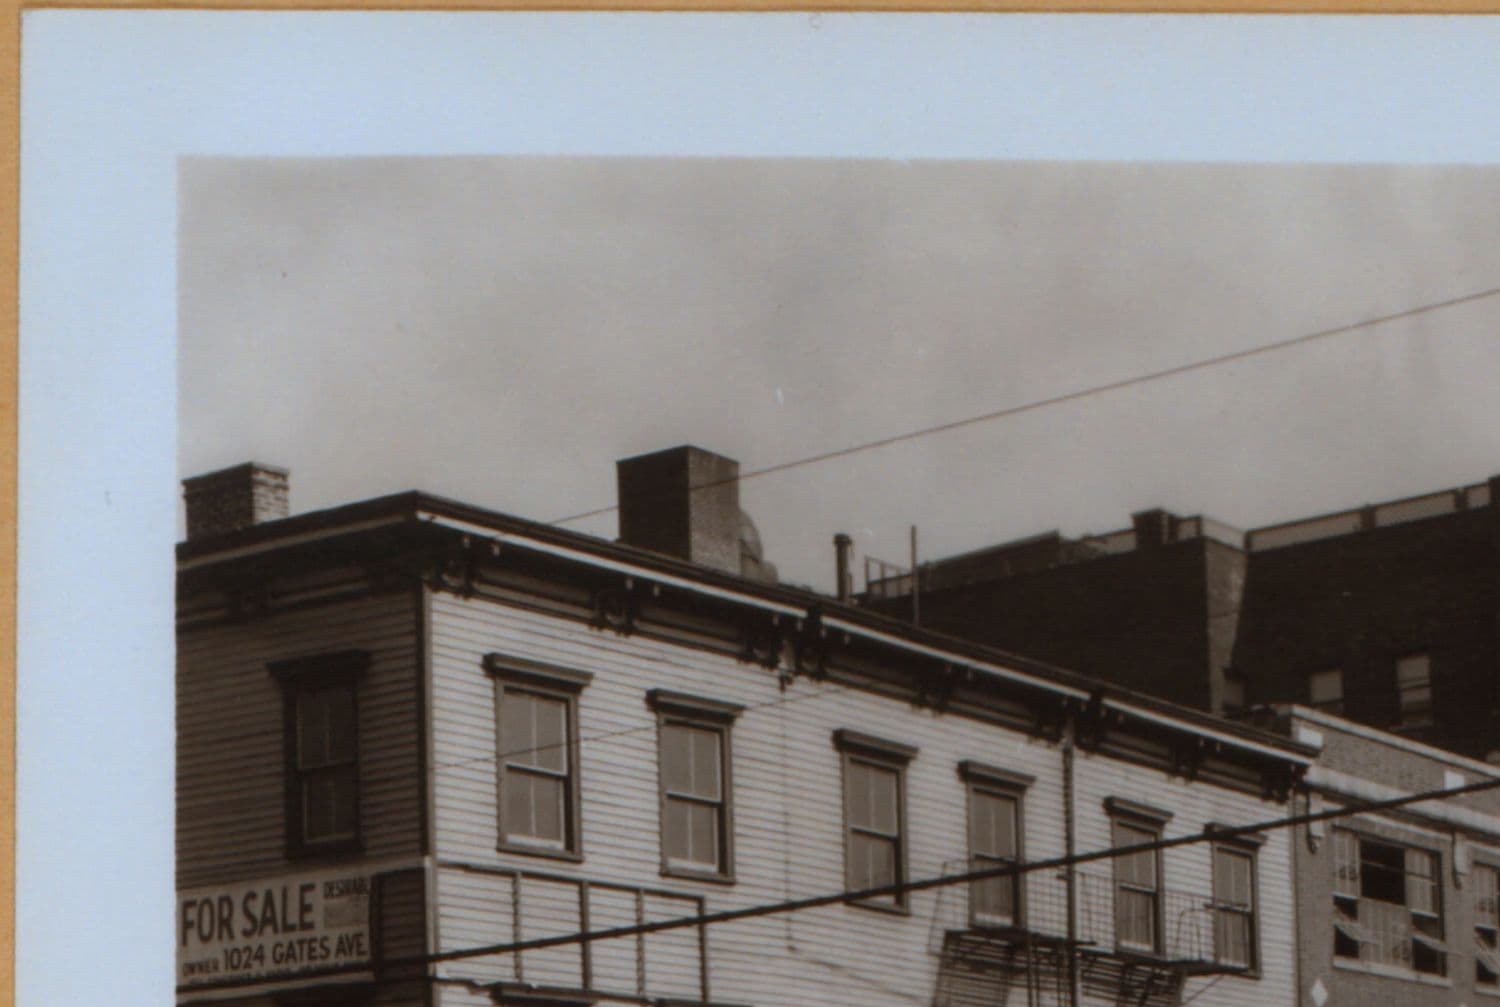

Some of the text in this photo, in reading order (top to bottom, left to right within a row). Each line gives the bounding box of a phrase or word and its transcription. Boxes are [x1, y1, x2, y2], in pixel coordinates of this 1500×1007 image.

[182, 896, 235, 948] FOR
[241, 884, 315, 938] SALE
[223, 943, 264, 973] 1024
[271, 937, 329, 966] GATES
